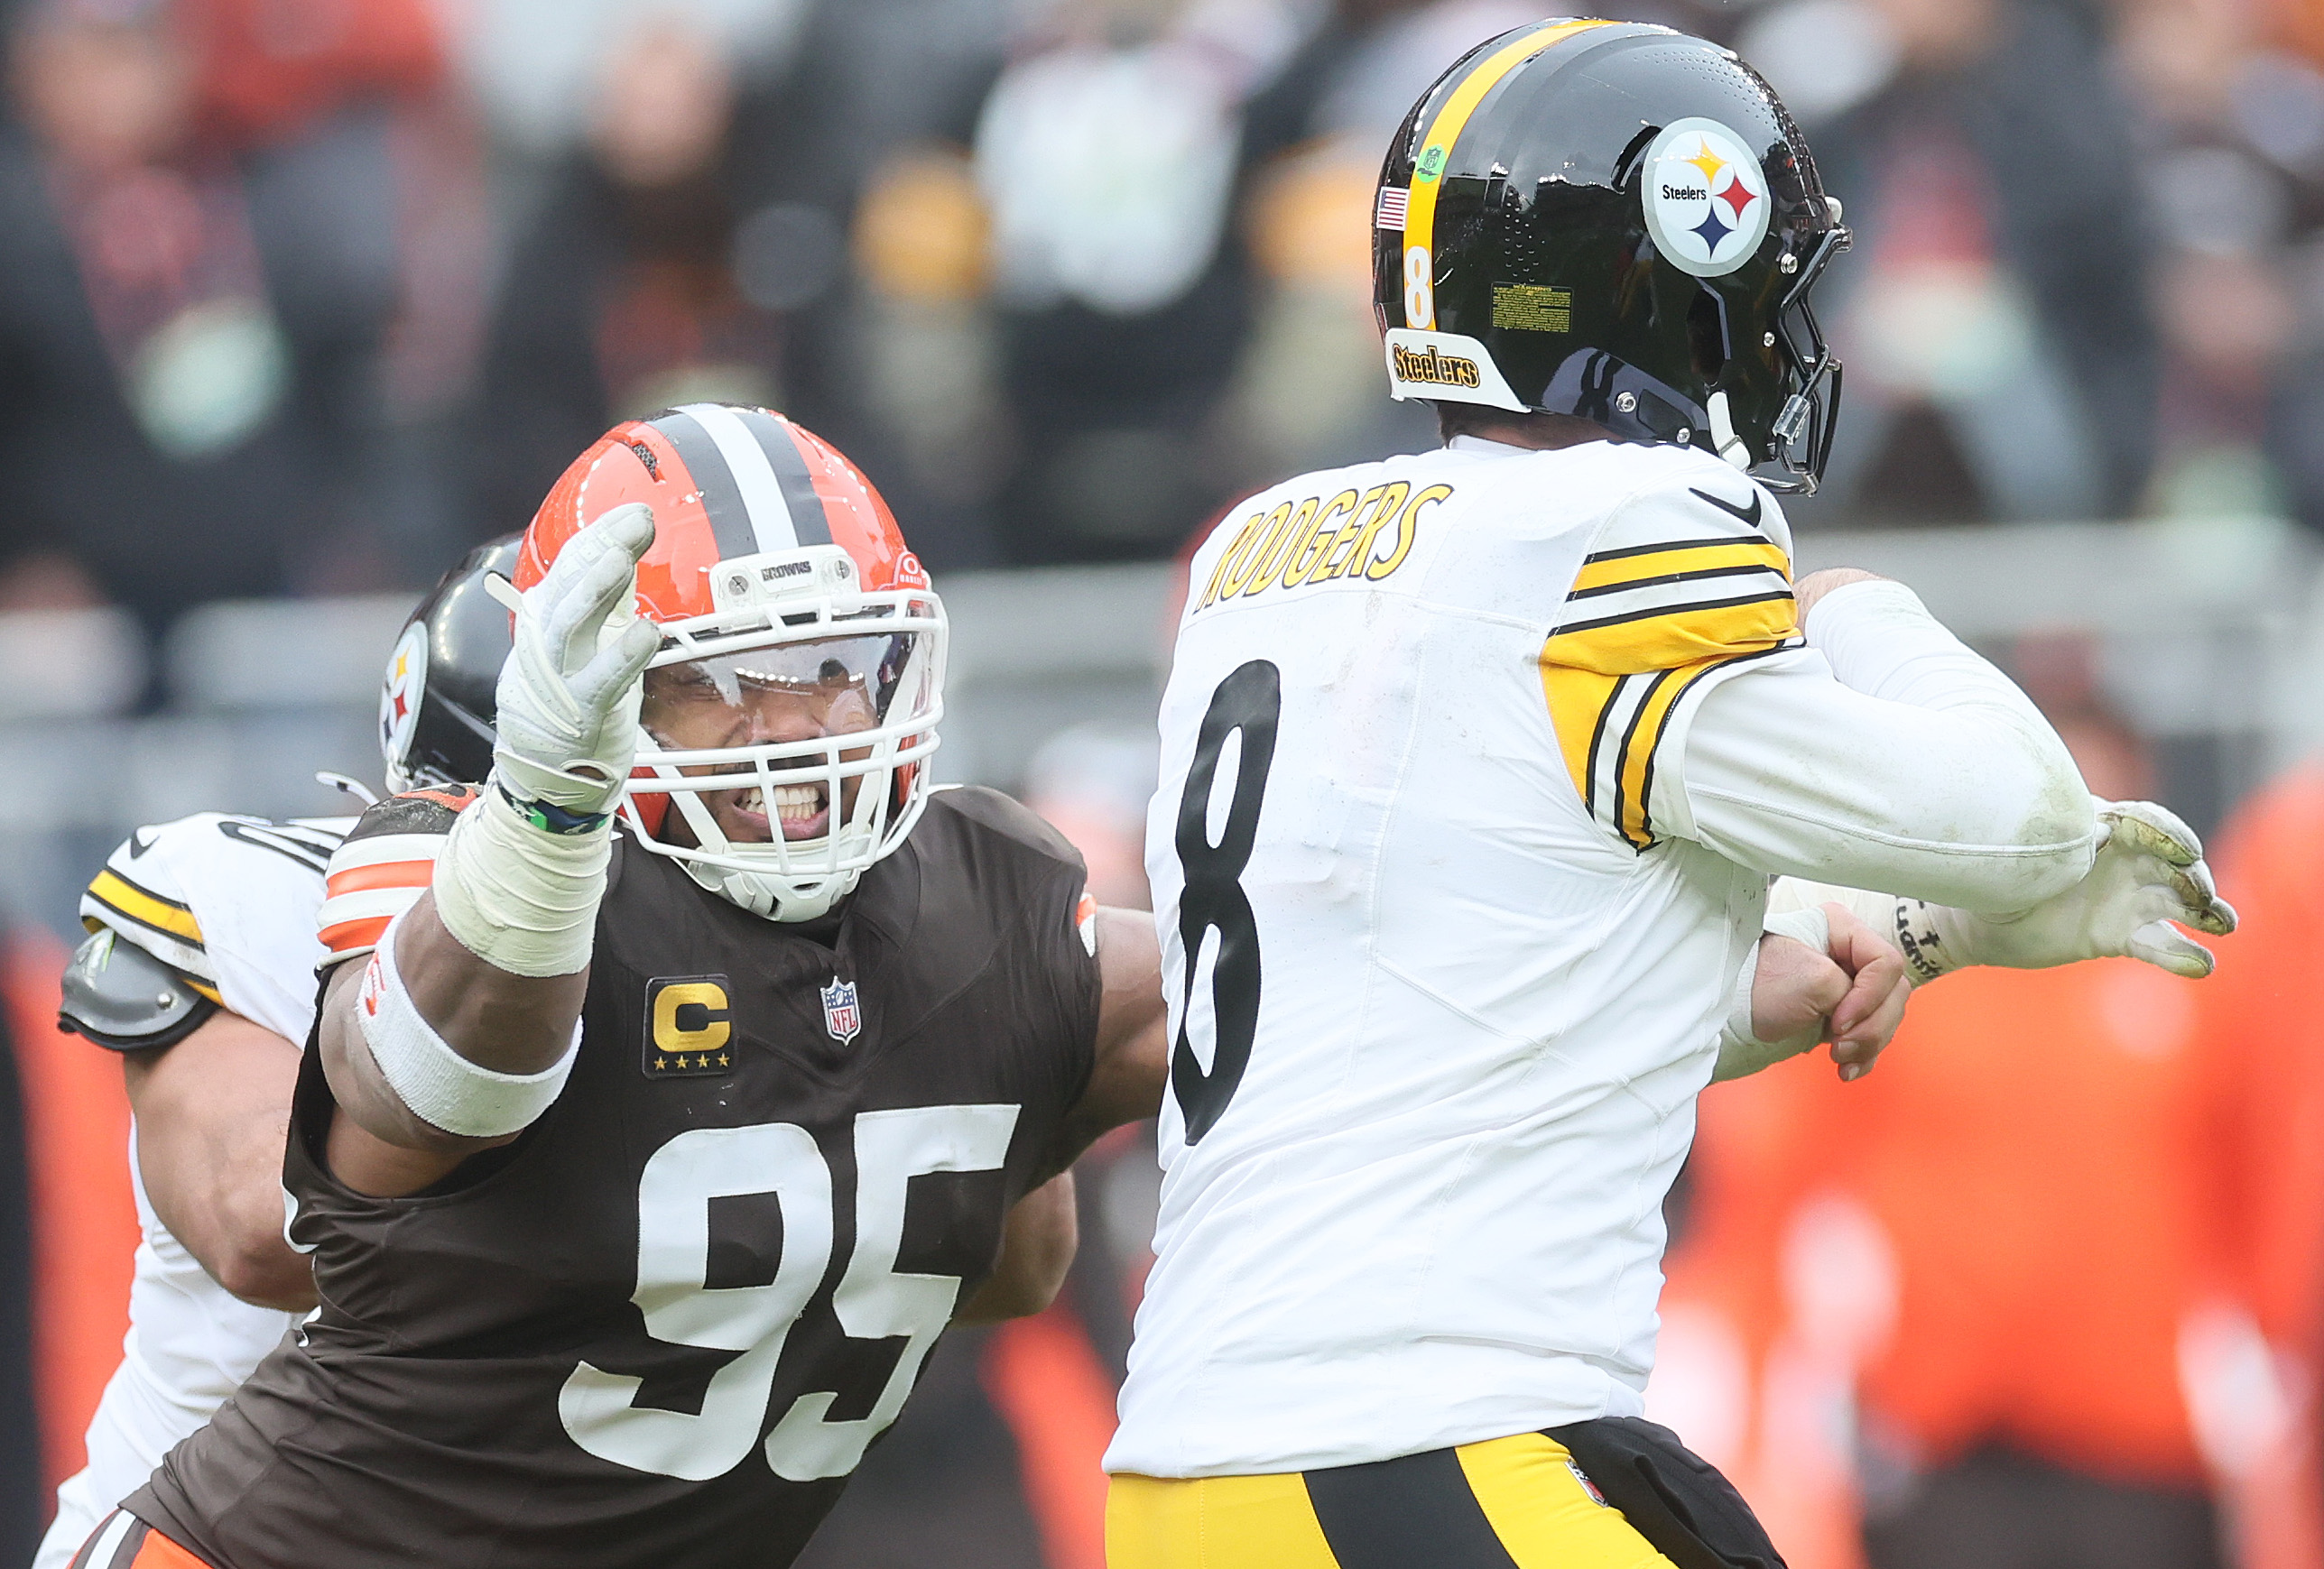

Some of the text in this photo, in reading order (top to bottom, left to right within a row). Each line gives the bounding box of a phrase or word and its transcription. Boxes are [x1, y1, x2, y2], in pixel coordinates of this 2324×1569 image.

[1662, 184, 1707, 200] Steelers
[1404, 245, 1432, 329] 8
[1393, 343, 1480, 388] Steelers
[761, 560, 812, 582] BROWNS
[1192, 480, 1455, 615] RODGERS
[1172, 659, 1282, 1147] 8
[653, 983, 732, 1053] C
[831, 1008, 857, 1033] NFL
[558, 1103, 1022, 1481] 95
